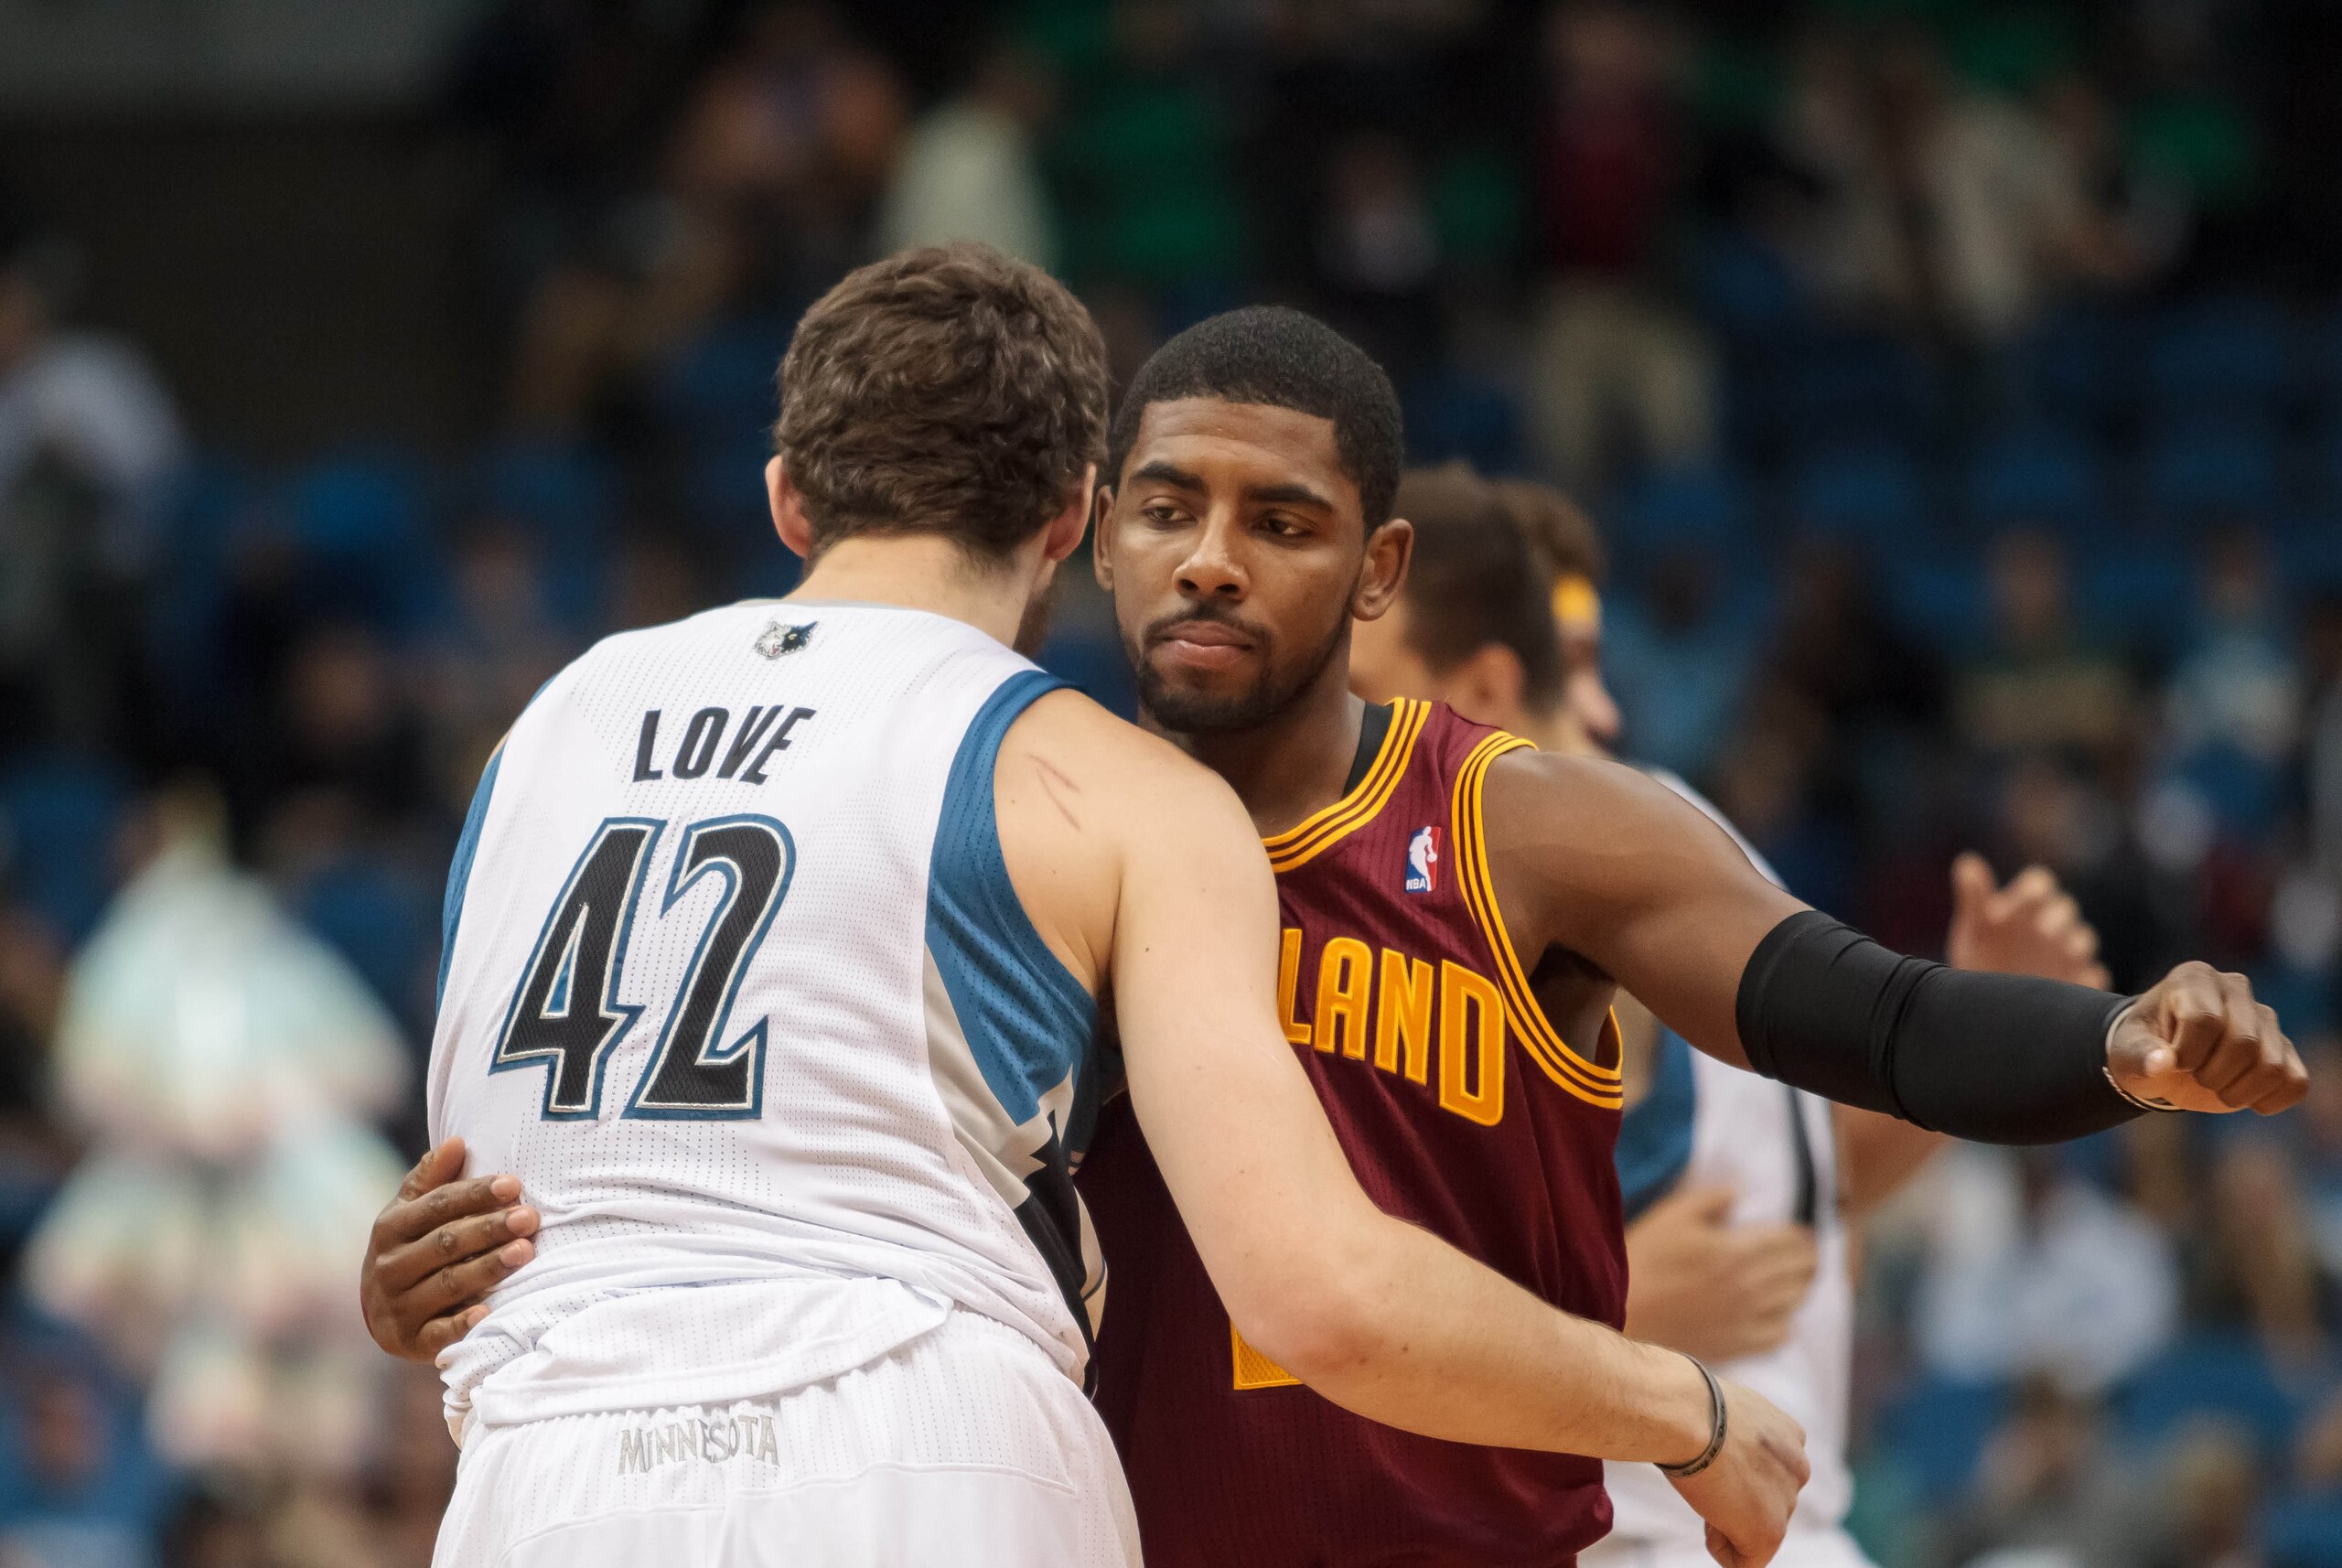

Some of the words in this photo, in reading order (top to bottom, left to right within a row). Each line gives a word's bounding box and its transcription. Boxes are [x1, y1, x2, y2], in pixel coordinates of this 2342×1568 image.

[632, 704, 817, 785] LOVE
[1405, 877, 1426, 891] NBA
[489, 813, 795, 1121] 42
[1277, 928, 1505, 1126] LAND
[618, 1414, 780, 1476] MINNESOTA
